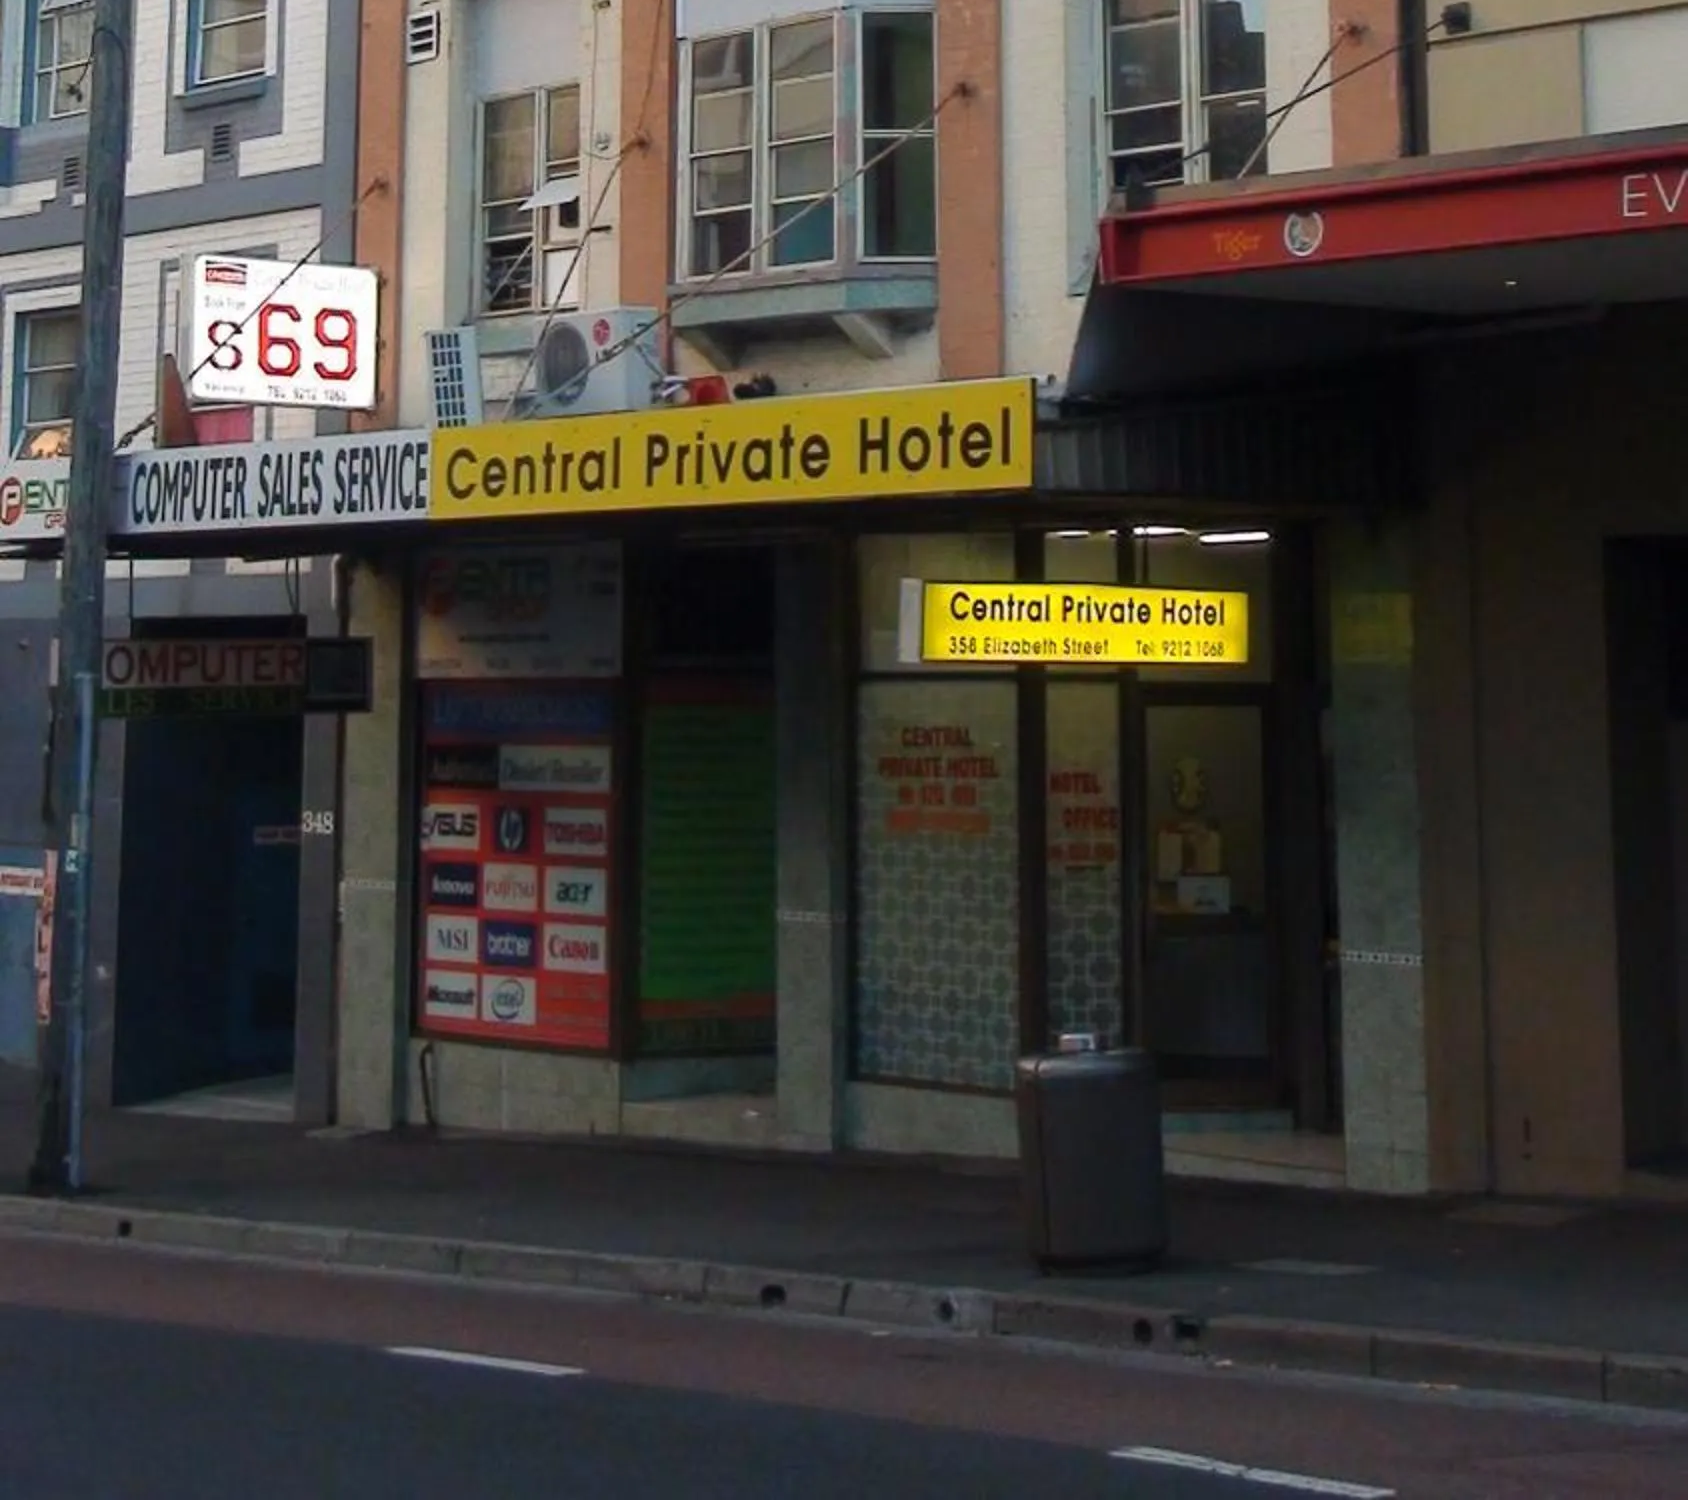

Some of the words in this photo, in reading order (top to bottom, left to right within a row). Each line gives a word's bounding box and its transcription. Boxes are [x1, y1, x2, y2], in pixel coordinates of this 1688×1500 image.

[1622, 172, 1688, 218] EV
[1212, 230, 1264, 261] Tiger
[446, 435, 621, 499] Central
[645, 423, 831, 487] Private
[858, 406, 1011, 474] Hotel
[132, 454, 246, 526] COMPUTER
[257, 447, 323, 518] SALES
[333, 441, 428, 515] SERVICE
[950, 591, 1050, 623] Central
[1062, 594, 1151, 626] Private
[1162, 597, 1225, 627] Hotel
[948, 636, 977, 655] 358
[983, 636, 1057, 656] Elizabeth
[1063, 638, 1109, 656] Street
[1162, 640, 1191, 657] 9212
[901, 726, 975, 747] CENTRAL
[878, 756, 942, 778] PRIVATE
[947, 756, 999, 778] HOTEL
[1050, 772, 1101, 794] HOTEL
[302, 810, 334, 835] 348
[1062, 806, 1118, 829] OFFICE
[556, 881, 593, 903] acer
[436, 928, 469, 951] MSI
[548, 935, 599, 961] Canon
